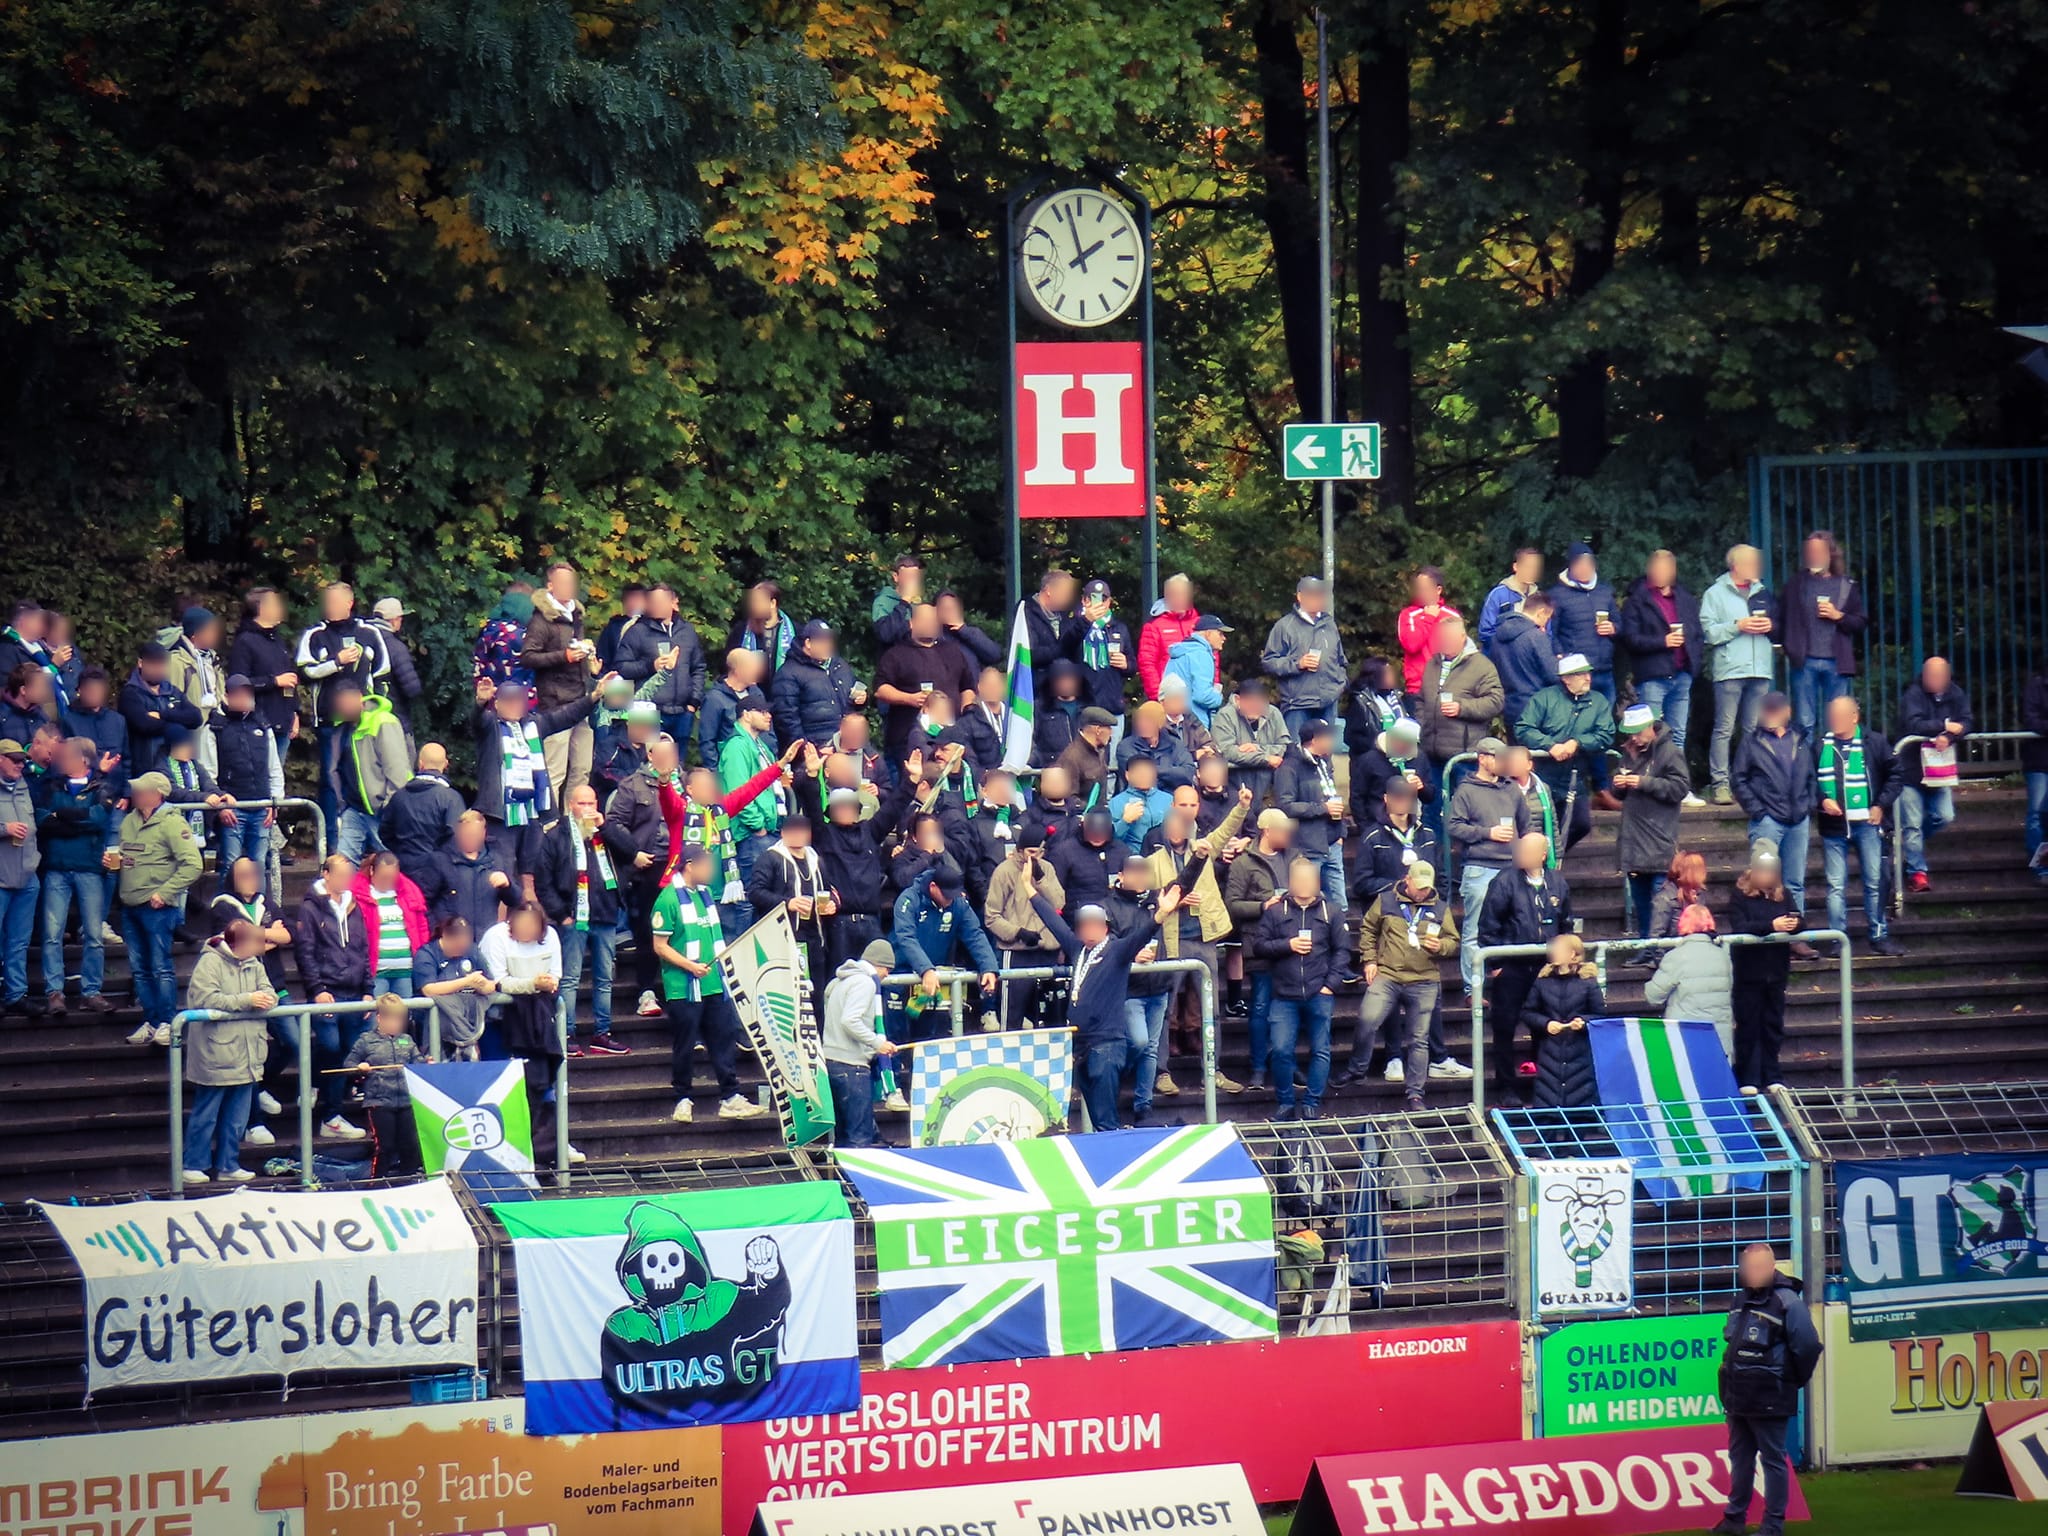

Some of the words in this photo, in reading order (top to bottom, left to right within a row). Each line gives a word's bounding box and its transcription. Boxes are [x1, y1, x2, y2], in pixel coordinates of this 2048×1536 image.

[1022, 373, 1136, 486] H
[471, 1112, 488, 1146] FCG
[166, 1210, 374, 1265] Aktive
[906, 1200, 1246, 1265] LEICESTER
[1971, 1241, 2004, 1260] SINCE
[1540, 1293, 1628, 1306] GUARDIA
[93, 1274, 474, 1369] Gütersloher
[1368, 1337, 1467, 1359] HAGEDORN
[1567, 1338, 1717, 1367] OHLENDORF
[616, 1354, 725, 1393] ULTRAS
[736, 1347, 777, 1384] GT
[1567, 1366, 1677, 1393] STADION
[1567, 1402, 1599, 1425] IM
[1607, 1394, 1727, 1422] HEIDEWA
[764, 1412, 1162, 1481] WERTSTOFFZENTRUM
[437, 1456, 534, 1504] Farbe
[602, 1463, 648, 1477] Maler-
[653, 1458, 680, 1474] und
[563, 1473, 718, 1499] Bodenbelagsarbeiten
[586, 1501, 617, 1515] vom
[621, 1494, 695, 1511] Fachmann
[1037, 1500, 1232, 1536] PANNHORST
